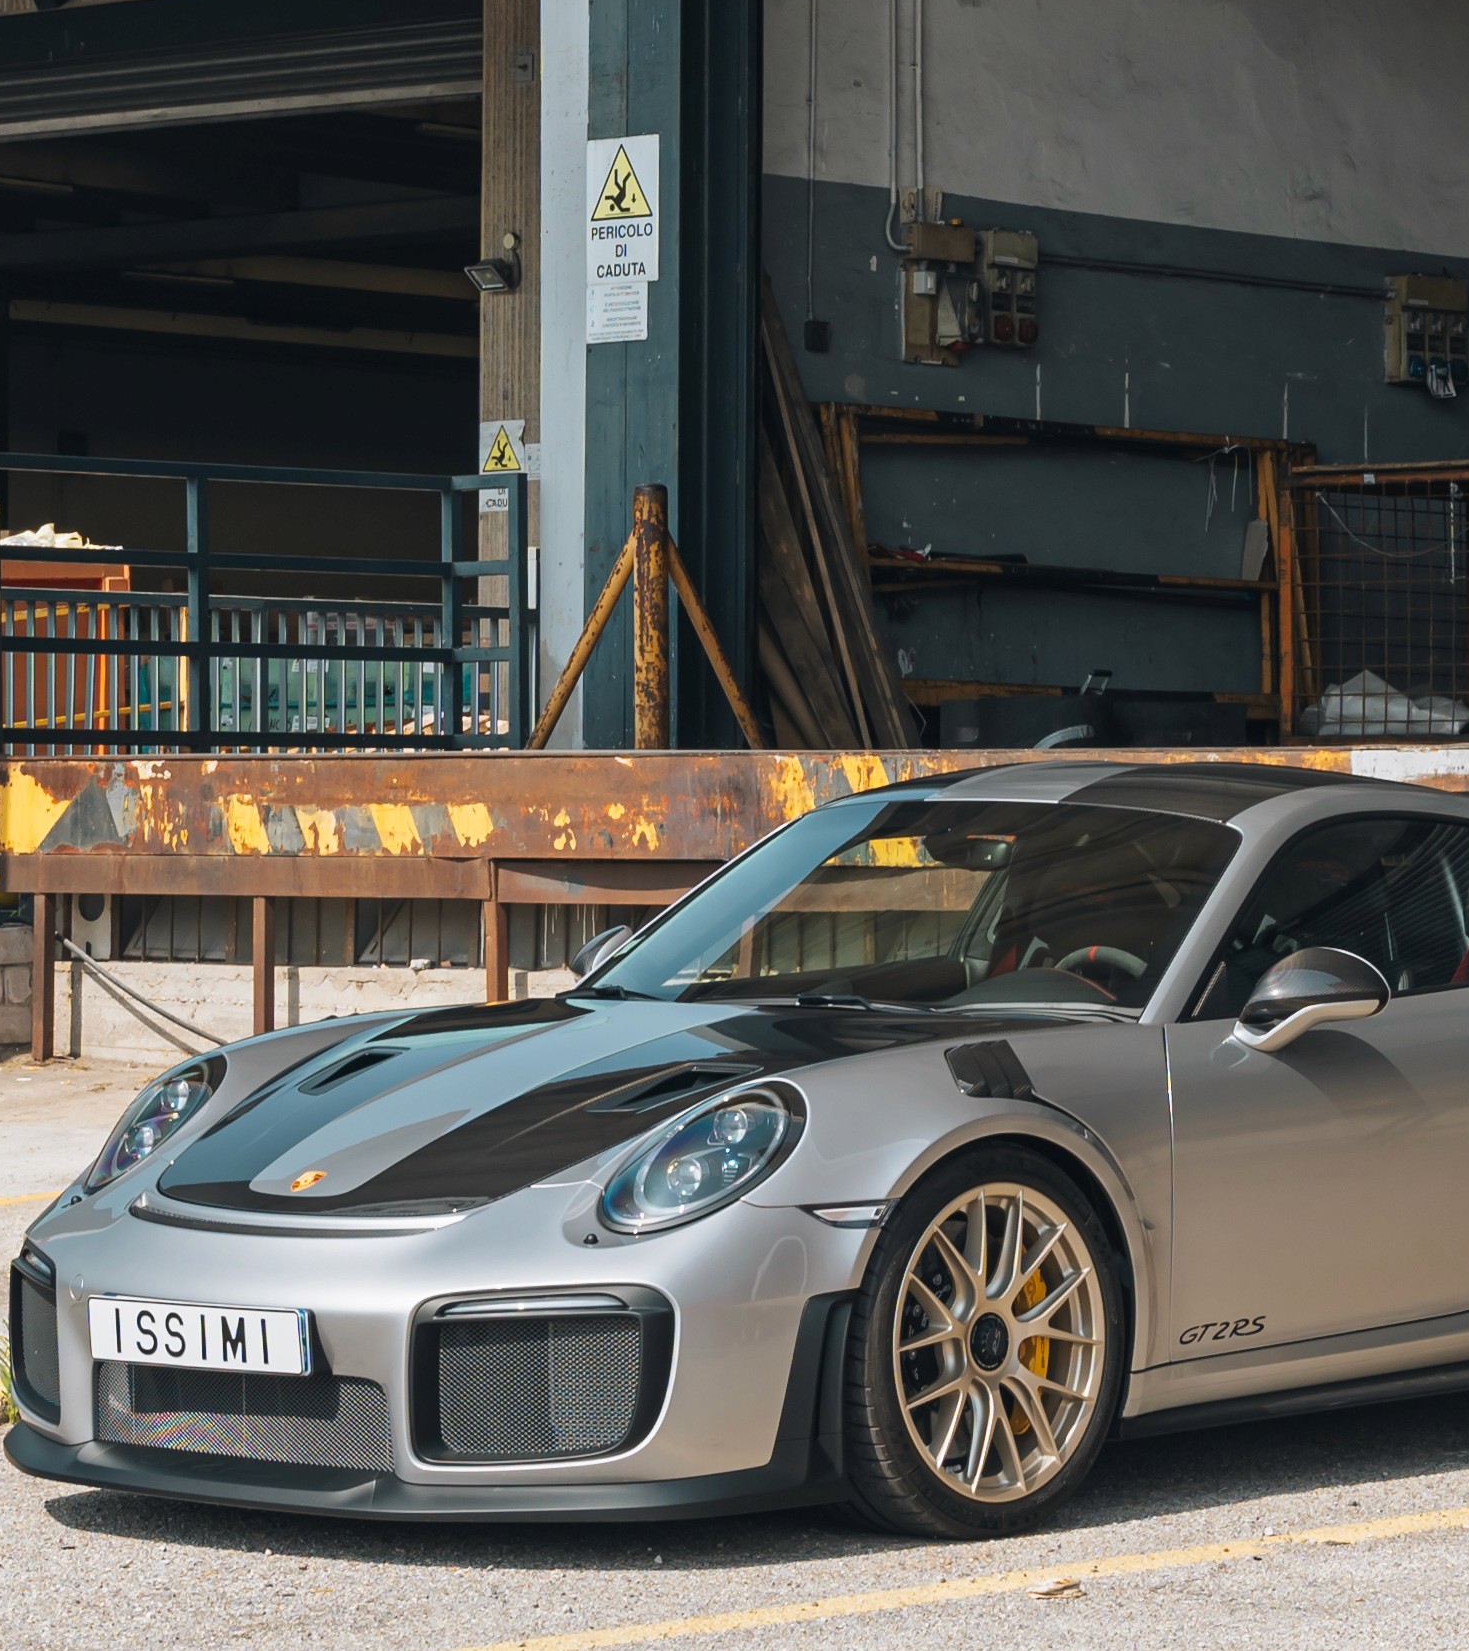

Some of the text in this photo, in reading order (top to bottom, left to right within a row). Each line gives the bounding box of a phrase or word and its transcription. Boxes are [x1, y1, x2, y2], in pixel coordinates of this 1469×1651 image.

[591, 222, 653, 241] PERICOLO
[615, 243, 627, 258] DI
[596, 261, 646, 278] CADUTA
[115, 1307, 269, 1364] ISSIMI
